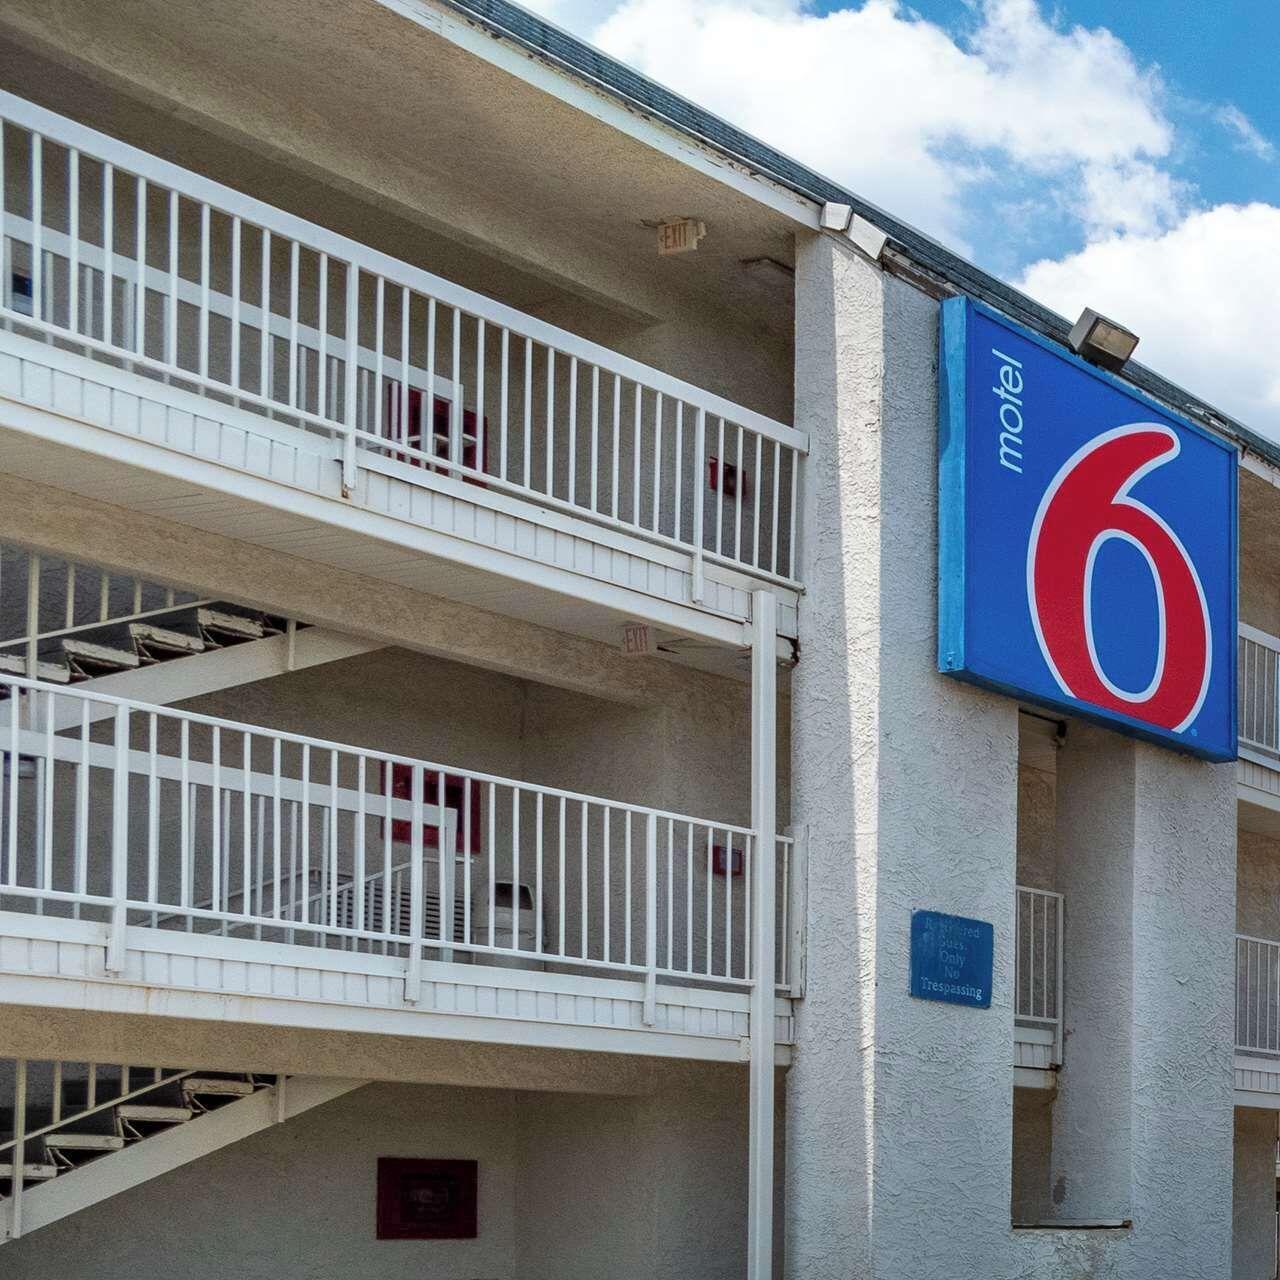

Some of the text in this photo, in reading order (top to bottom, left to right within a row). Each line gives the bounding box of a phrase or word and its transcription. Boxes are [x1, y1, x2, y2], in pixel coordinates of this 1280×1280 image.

[664, 223, 688, 249] EXIT
[991, 347, 1023, 474] motel
[1026, 422, 1213, 734] 6
[625, 626, 648, 653] EXIT
[940, 950, 966, 968] Only
[920, 976, 983, 1001] Trespassing
